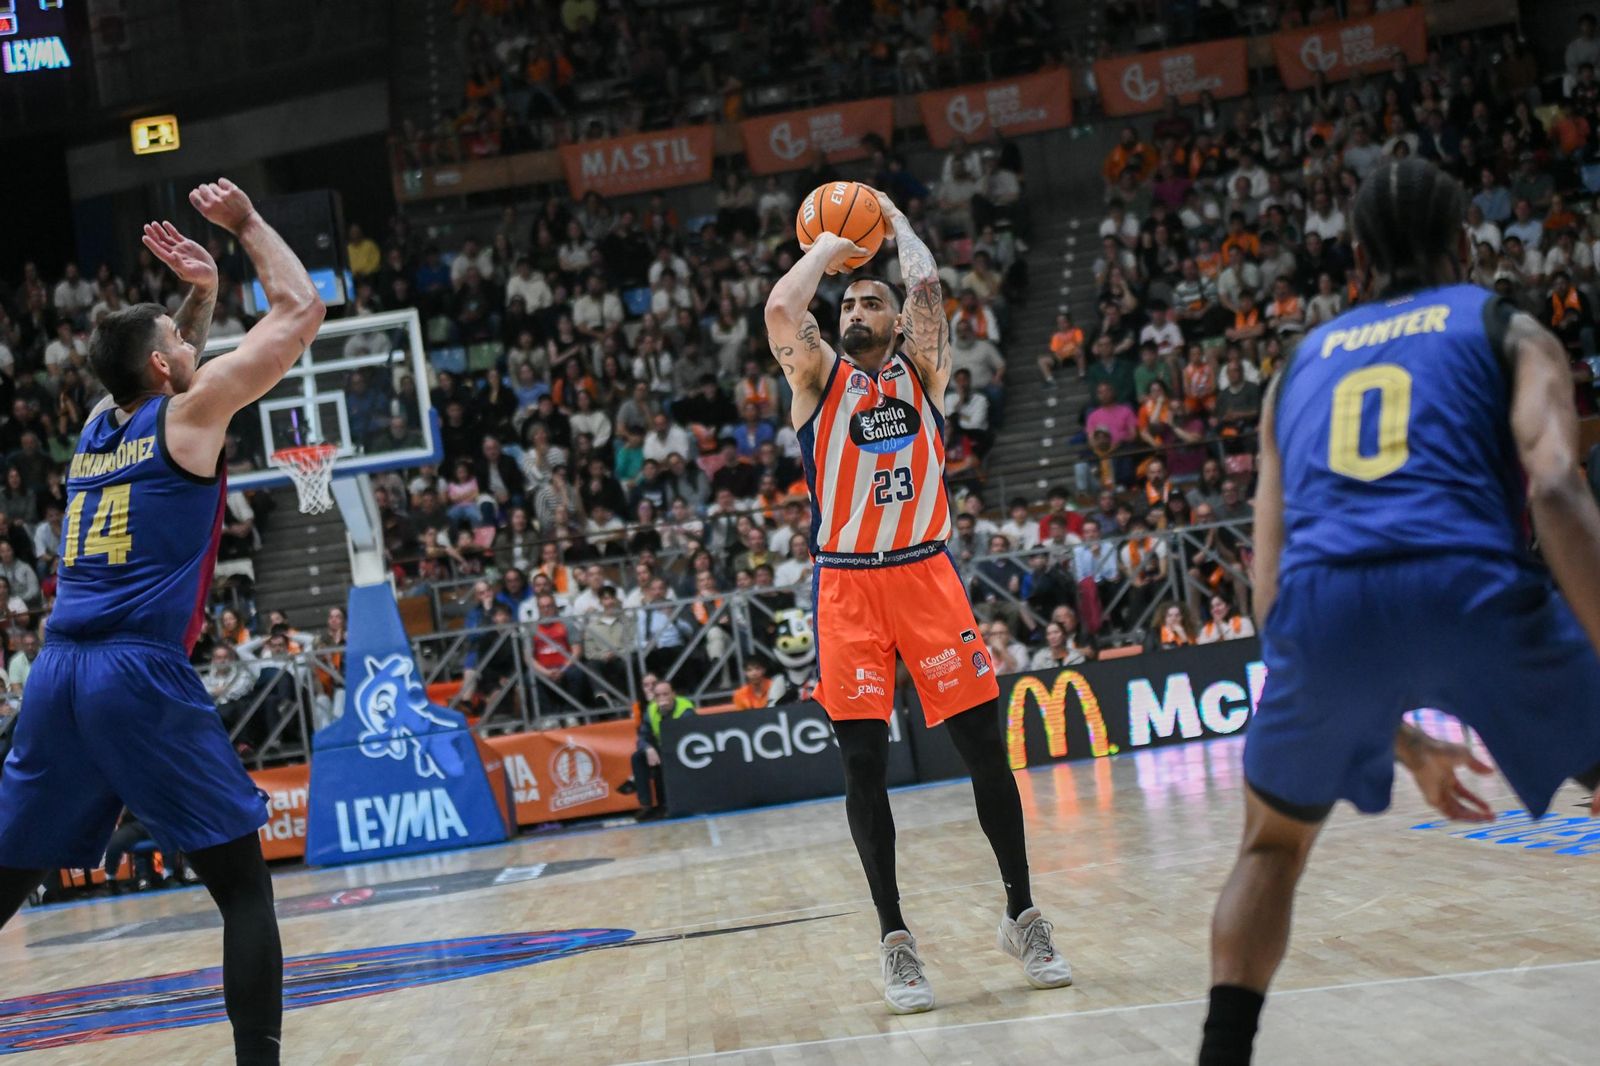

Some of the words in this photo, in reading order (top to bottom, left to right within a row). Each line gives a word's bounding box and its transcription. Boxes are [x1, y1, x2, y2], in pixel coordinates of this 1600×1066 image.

[2, 36, 71, 74] LEYMA
[580, 137, 697, 178] MASTIL
[1321, 304, 1451, 359] PUNTER
[860, 406, 906, 428] Estrella
[863, 421, 908, 441] Galicia
[1328, 363, 1412, 483] 0
[873, 466, 915, 507] 23
[63, 483, 132, 567] 14
[925, 648, 956, 665] Coruña
[335, 788, 469, 853] LEYMA
